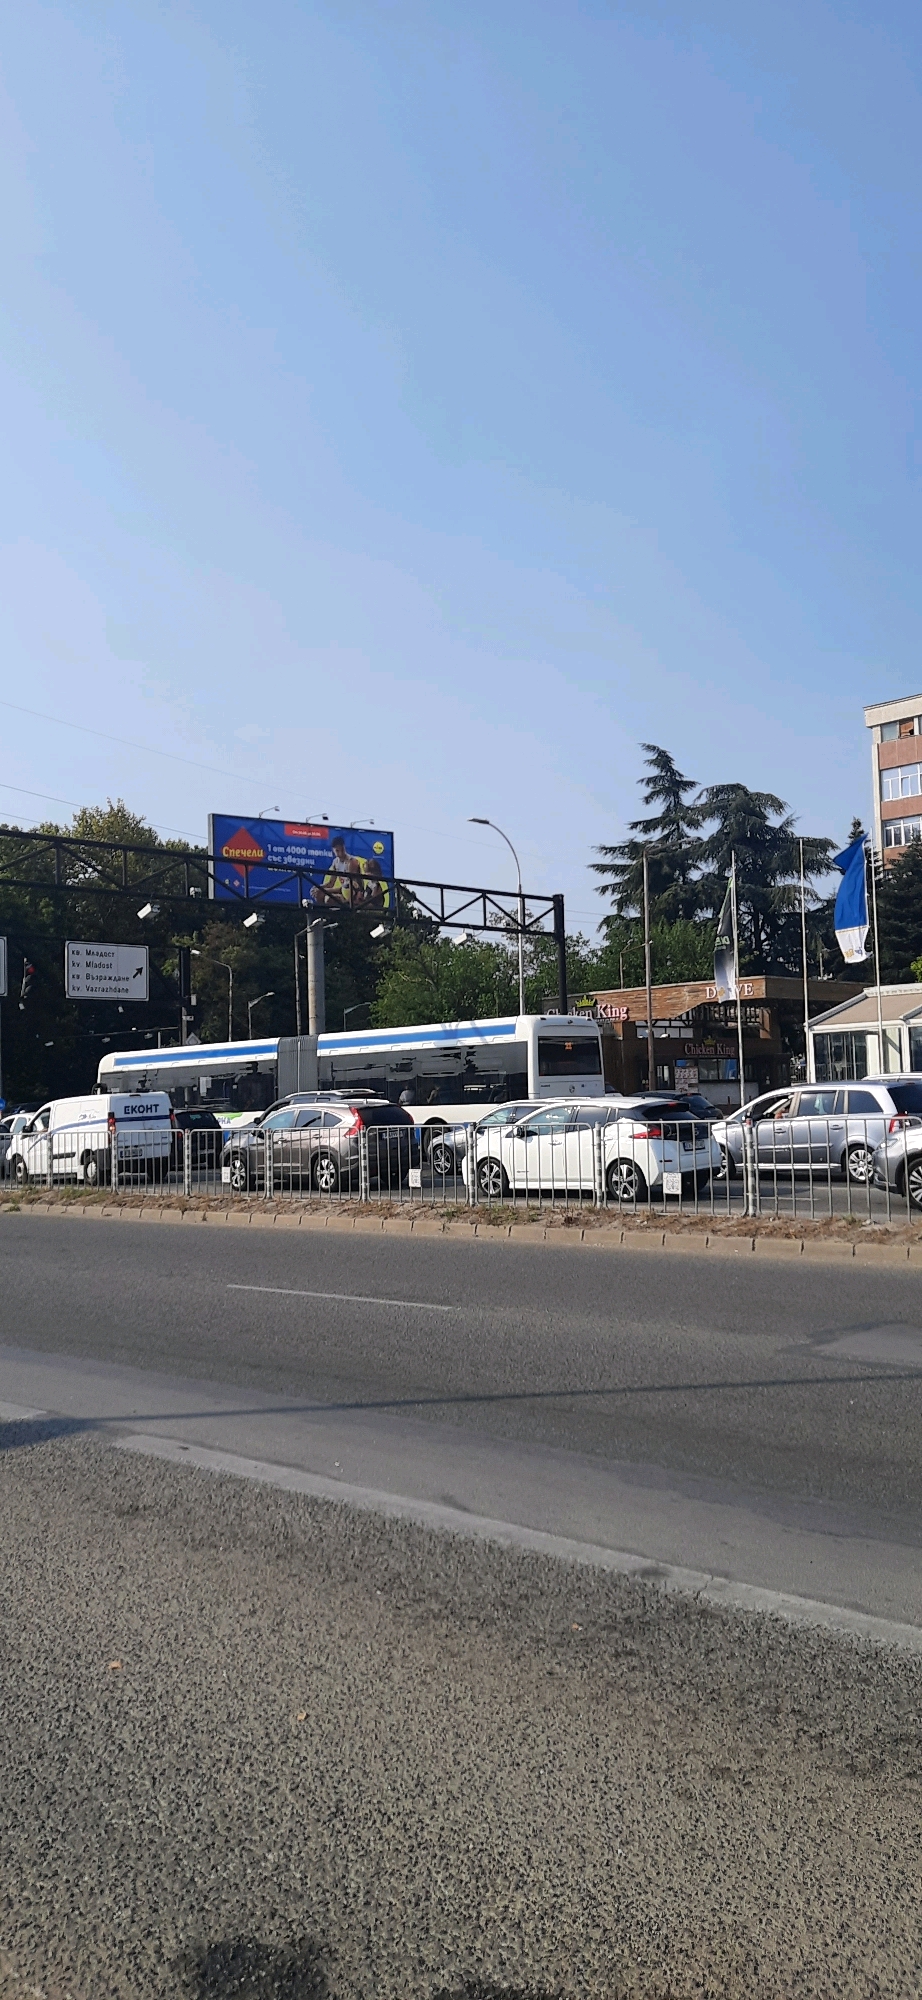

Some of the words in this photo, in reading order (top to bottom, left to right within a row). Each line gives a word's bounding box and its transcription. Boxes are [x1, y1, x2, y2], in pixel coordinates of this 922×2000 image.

[222, 846, 264, 858] Спечели
[267, 844, 272, 852] 1
[286, 845, 307, 855] 4000
[283, 856, 315, 866] звездни
[85, 949, 115, 958] Младост
[85, 961, 113, 969] Mladost
[85, 973, 130, 982] Възраждане
[85, 985, 129, 994] Vazrazhdane
[596, 1004, 628, 1020] King
[684, 1042, 715, 1055] Chicken
[716, 1043, 735, 1057] King
[124, 1104, 160, 1114] ЕКОНТ
